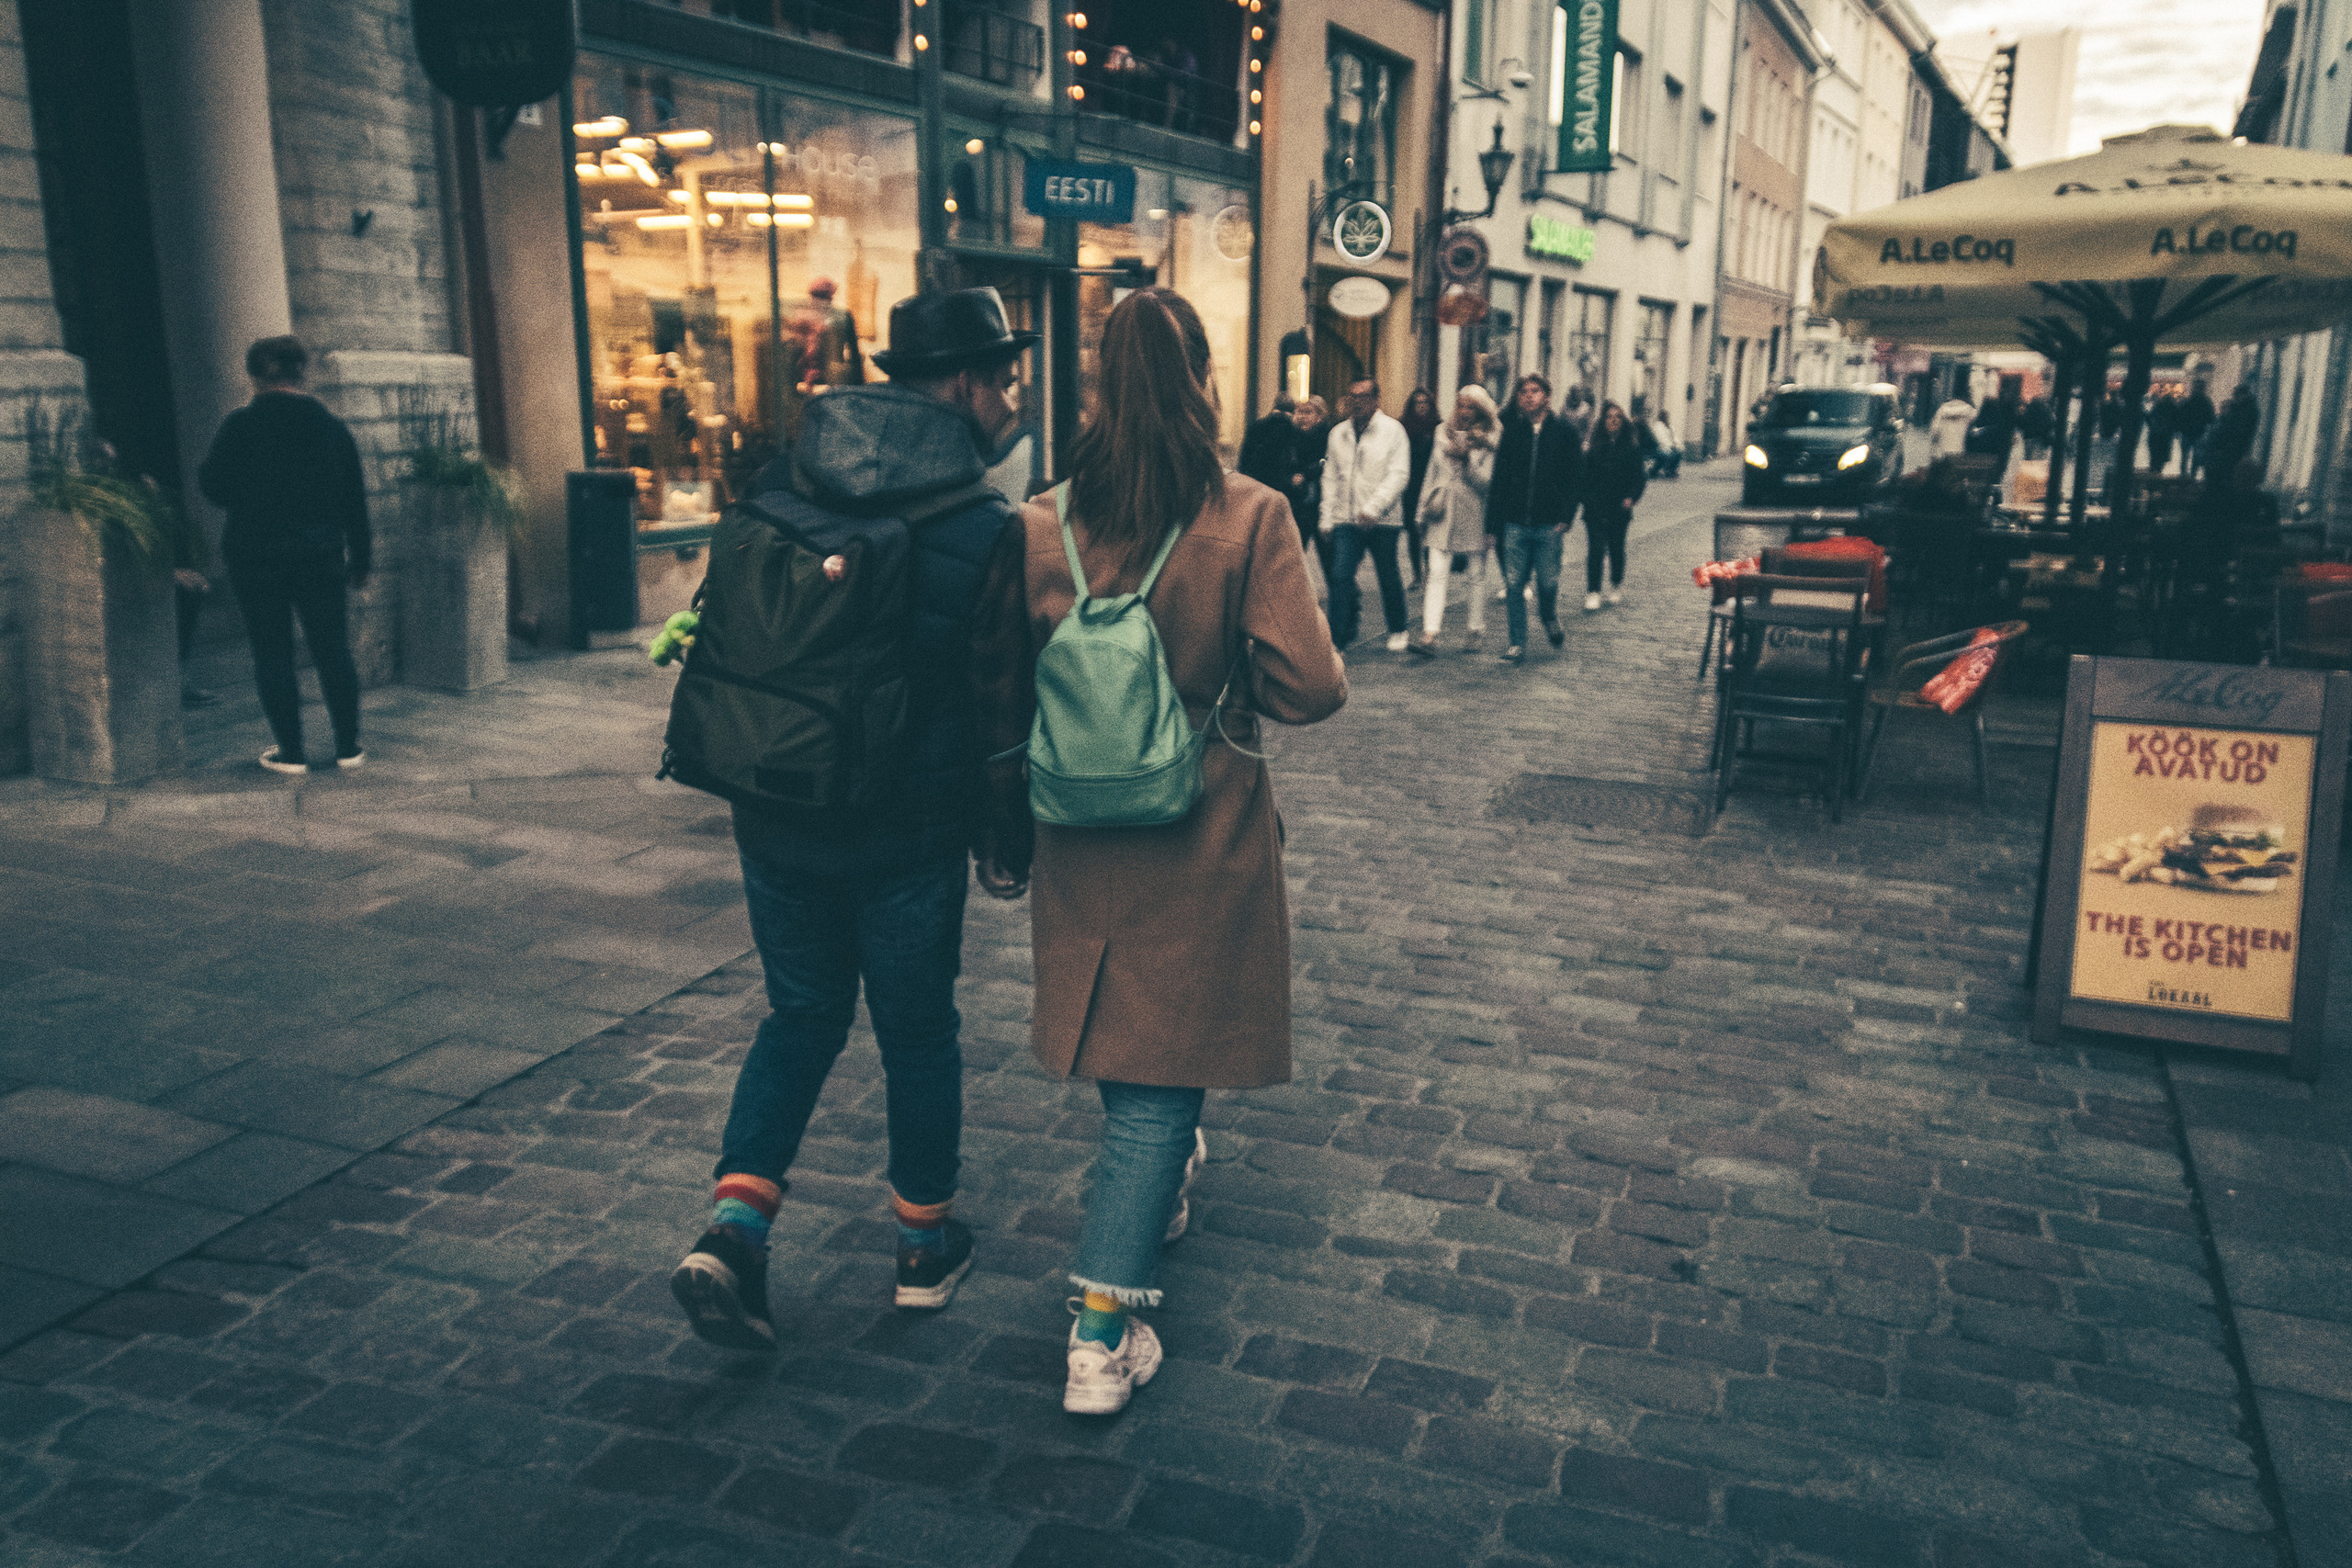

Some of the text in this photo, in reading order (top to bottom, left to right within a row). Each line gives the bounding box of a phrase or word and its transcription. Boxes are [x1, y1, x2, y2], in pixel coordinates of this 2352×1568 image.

[1572, 0, 1605, 154] SALAMAND
[1044, 175, 1115, 206] EESTI
[2127, 730, 2279, 765] KÖÖK ON
[2134, 756, 2267, 784] AVATUD
[2086, 910, 2292, 953] THE KITCHEN
[2123, 937, 2249, 969] IS OPEN
